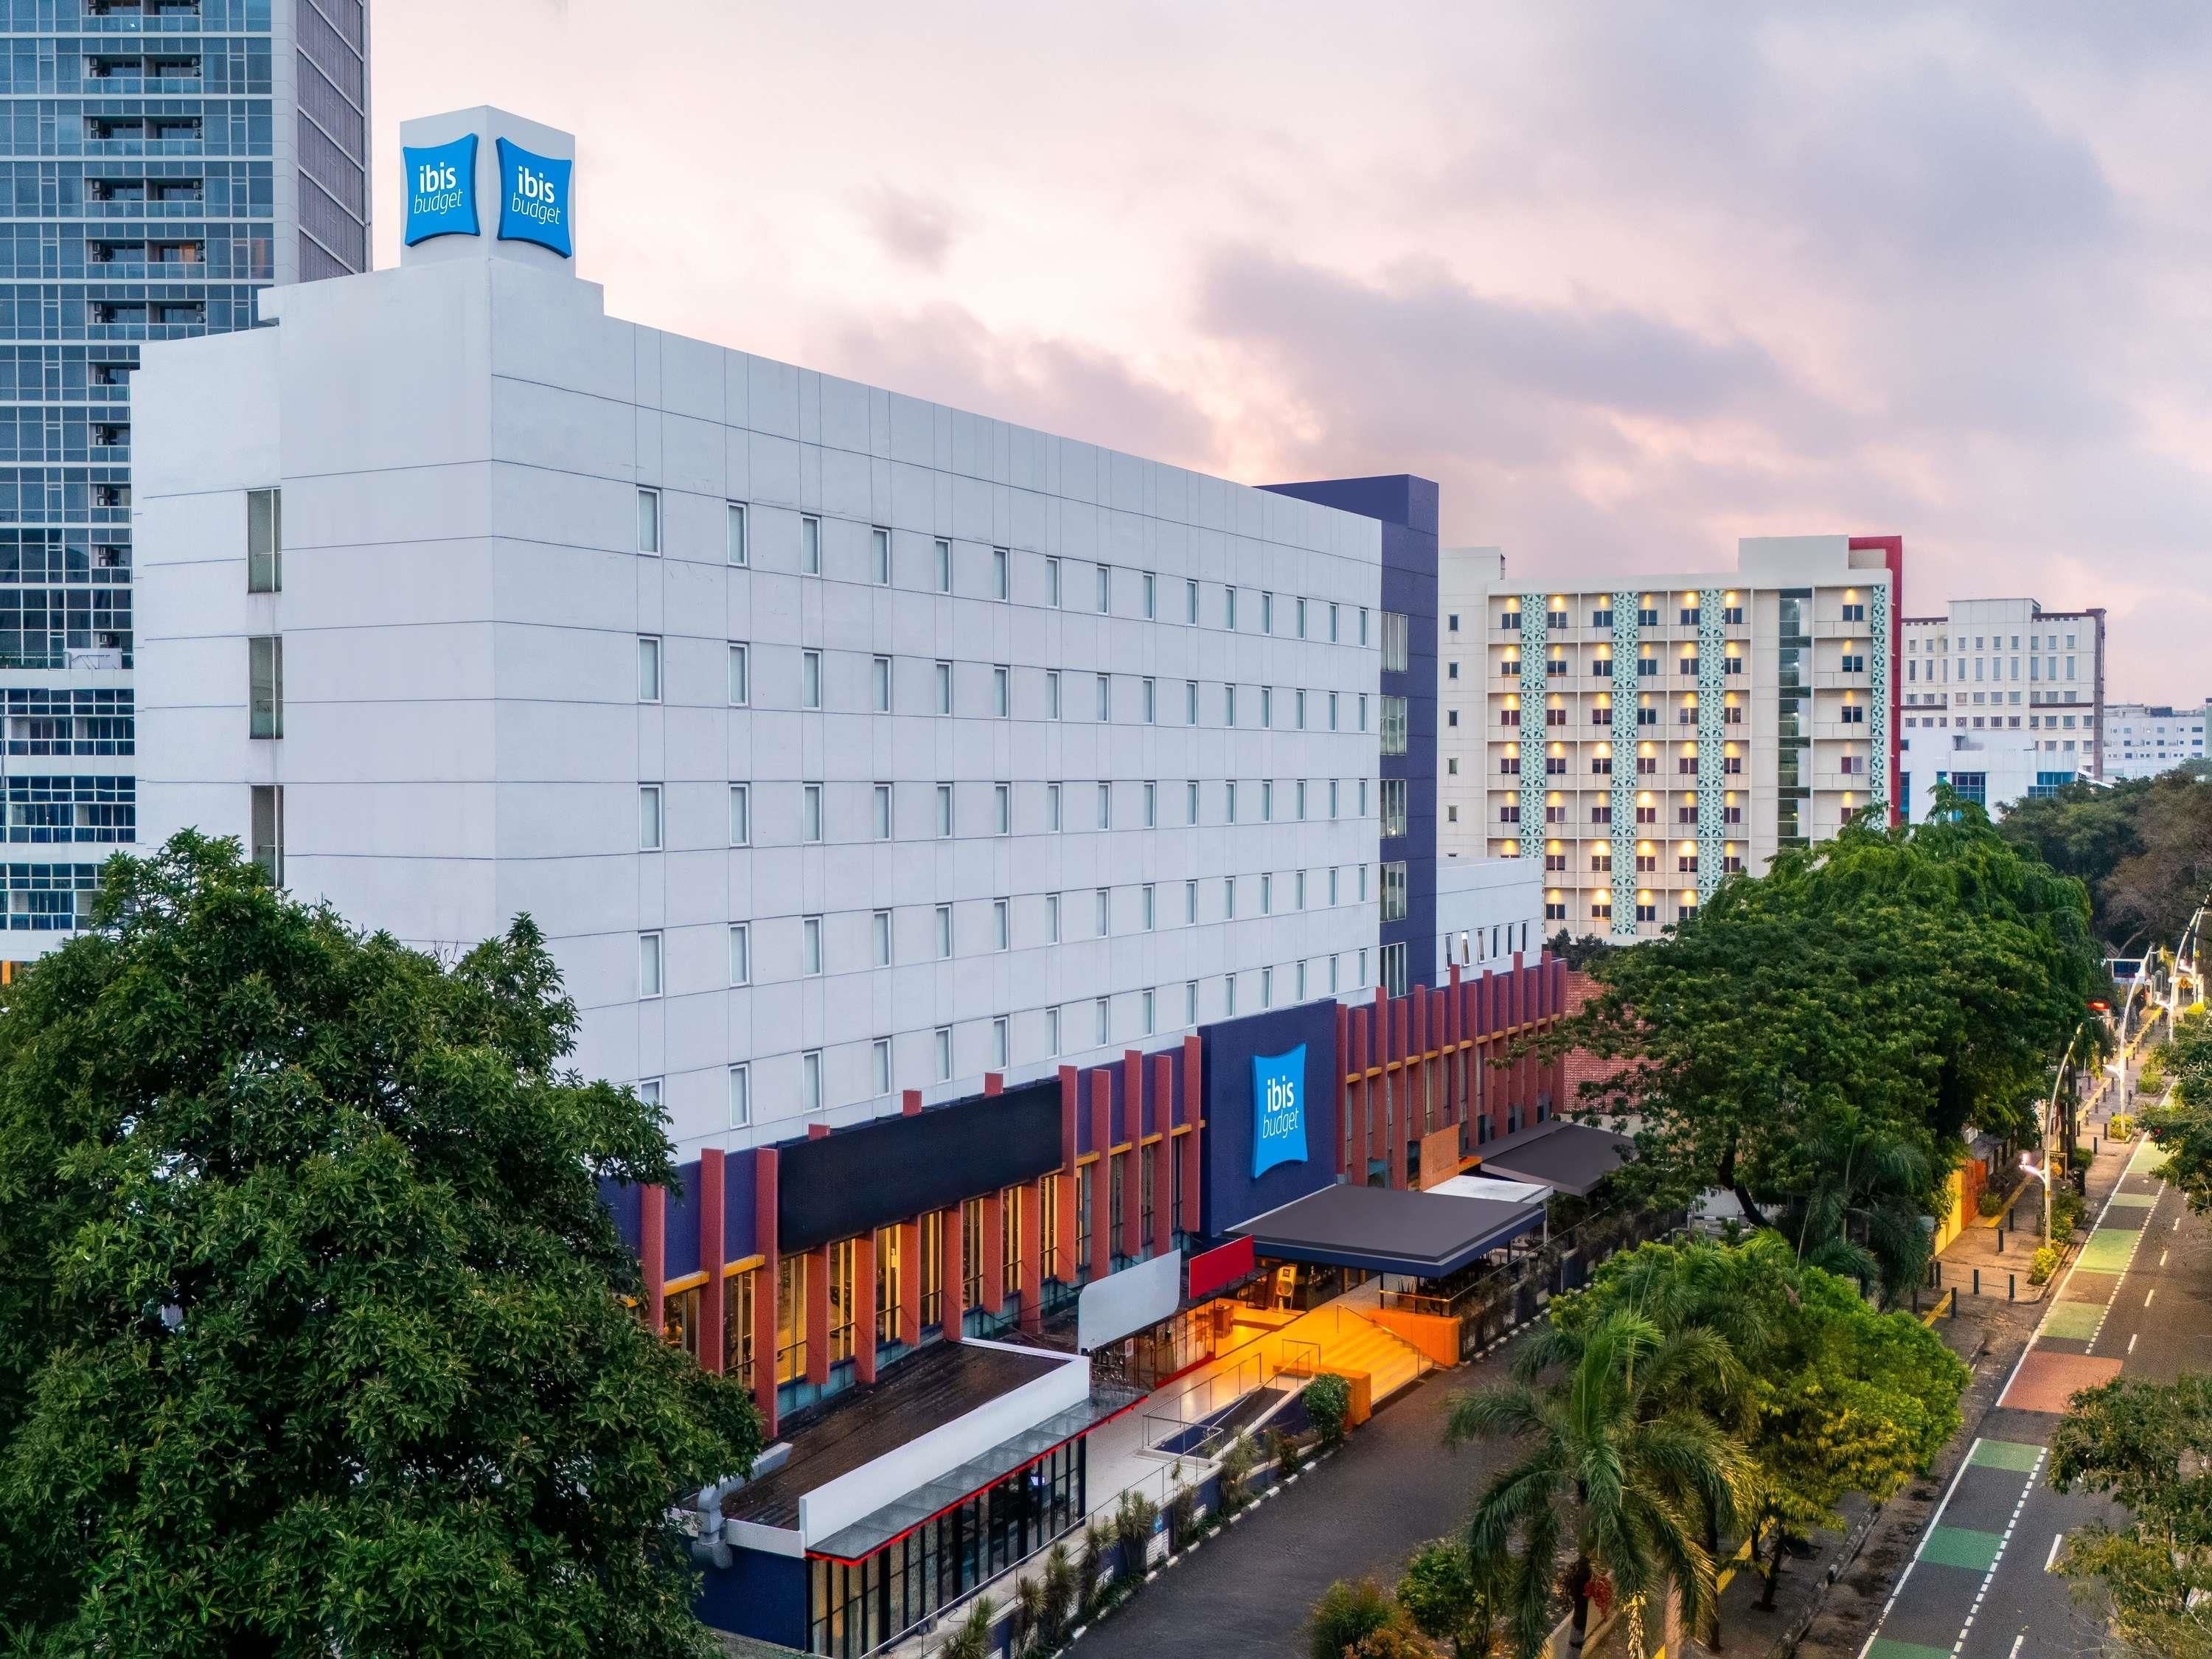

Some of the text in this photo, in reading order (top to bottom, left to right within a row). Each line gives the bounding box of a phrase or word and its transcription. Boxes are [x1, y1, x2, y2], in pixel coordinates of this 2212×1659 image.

[420, 161, 456, 193] ibis
[518, 165, 554, 204] ibis
[414, 189, 464, 215] budget
[512, 192, 561, 225] budget
[1267, 1075, 1294, 1113] ibis
[1262, 1107, 1299, 1139] budget
